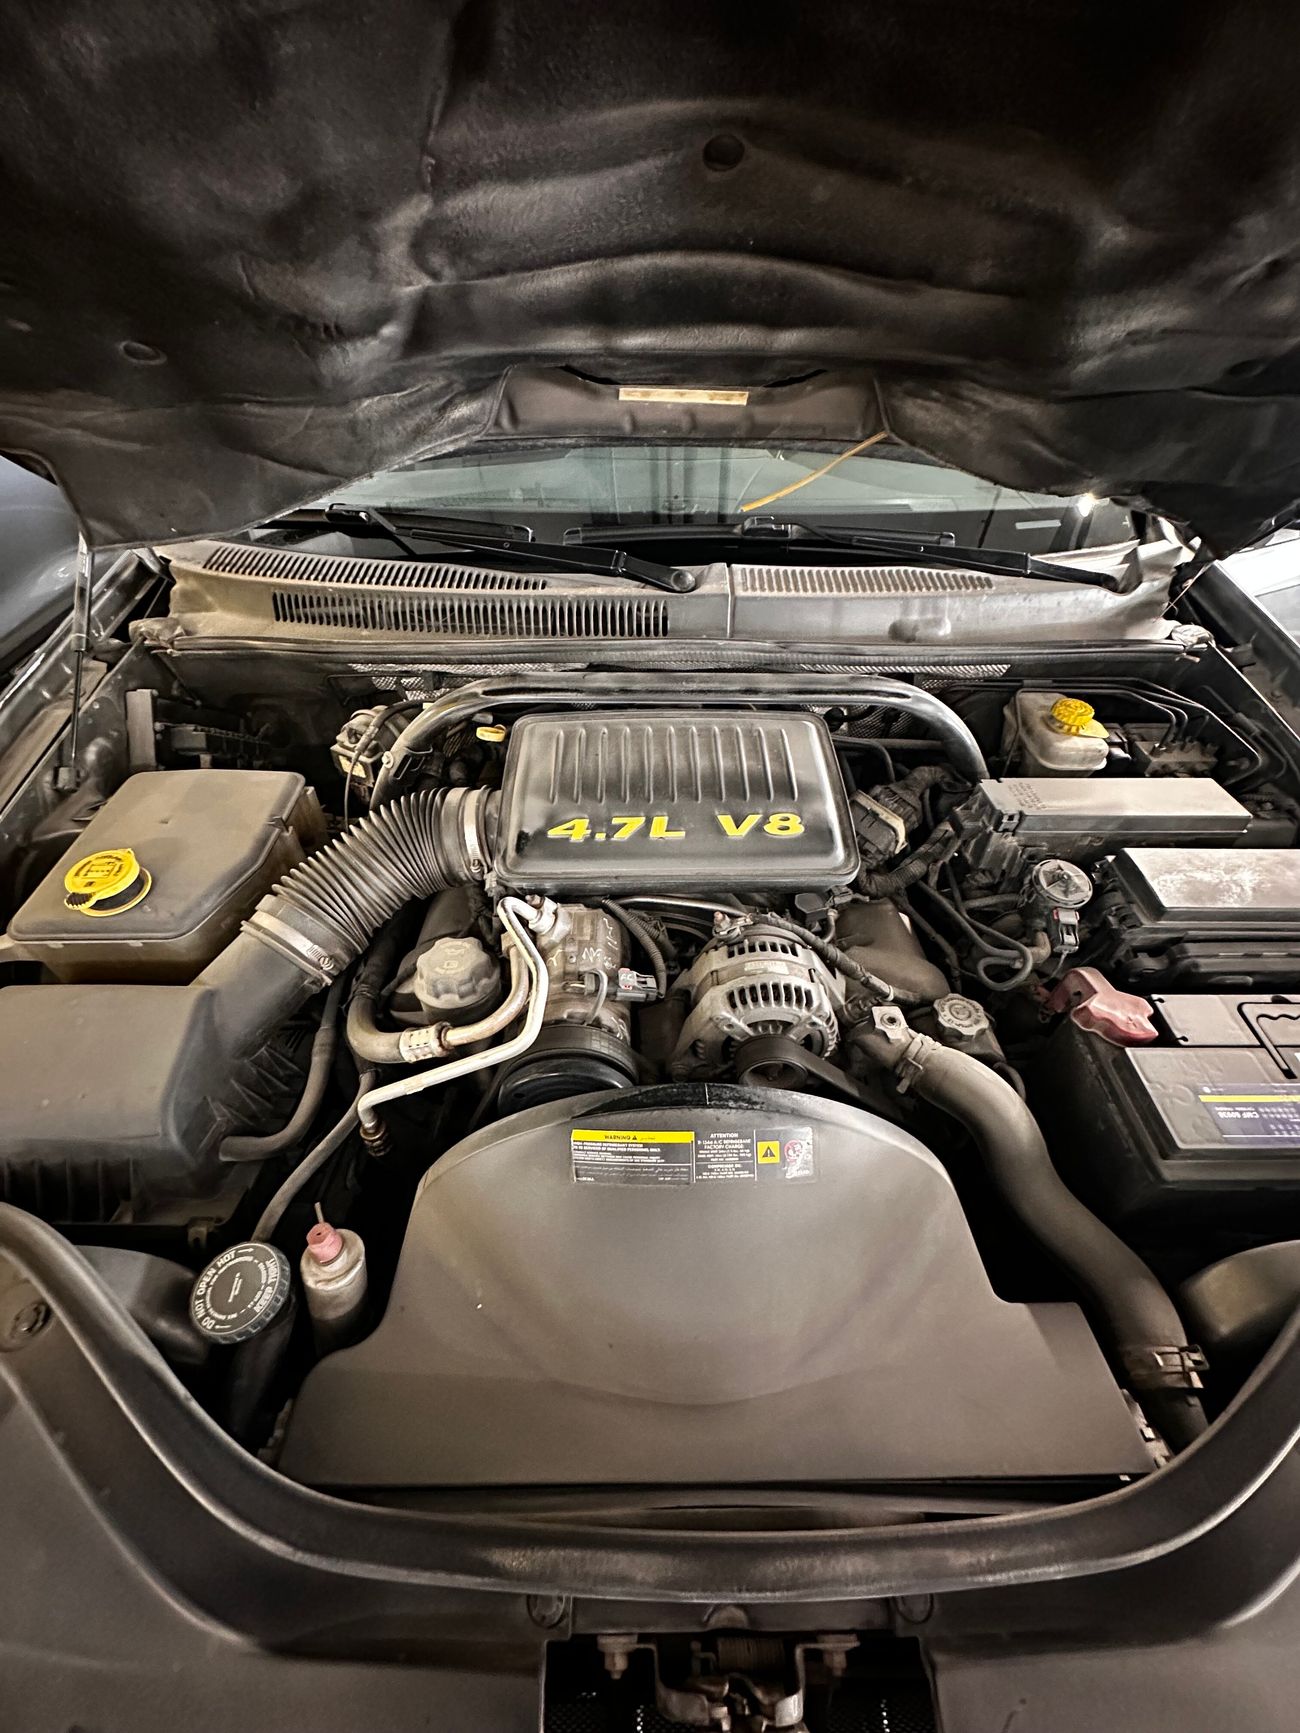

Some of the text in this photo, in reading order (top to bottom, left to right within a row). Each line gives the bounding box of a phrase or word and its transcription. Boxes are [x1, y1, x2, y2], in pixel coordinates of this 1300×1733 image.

[547, 813, 805, 842] 4.7L V8
[216, 1251, 236, 1267] HOT
[196, 1267, 217, 1296] OPEN
[194, 1298, 206, 1319] NOT
[201, 1316, 216, 1330] DO
